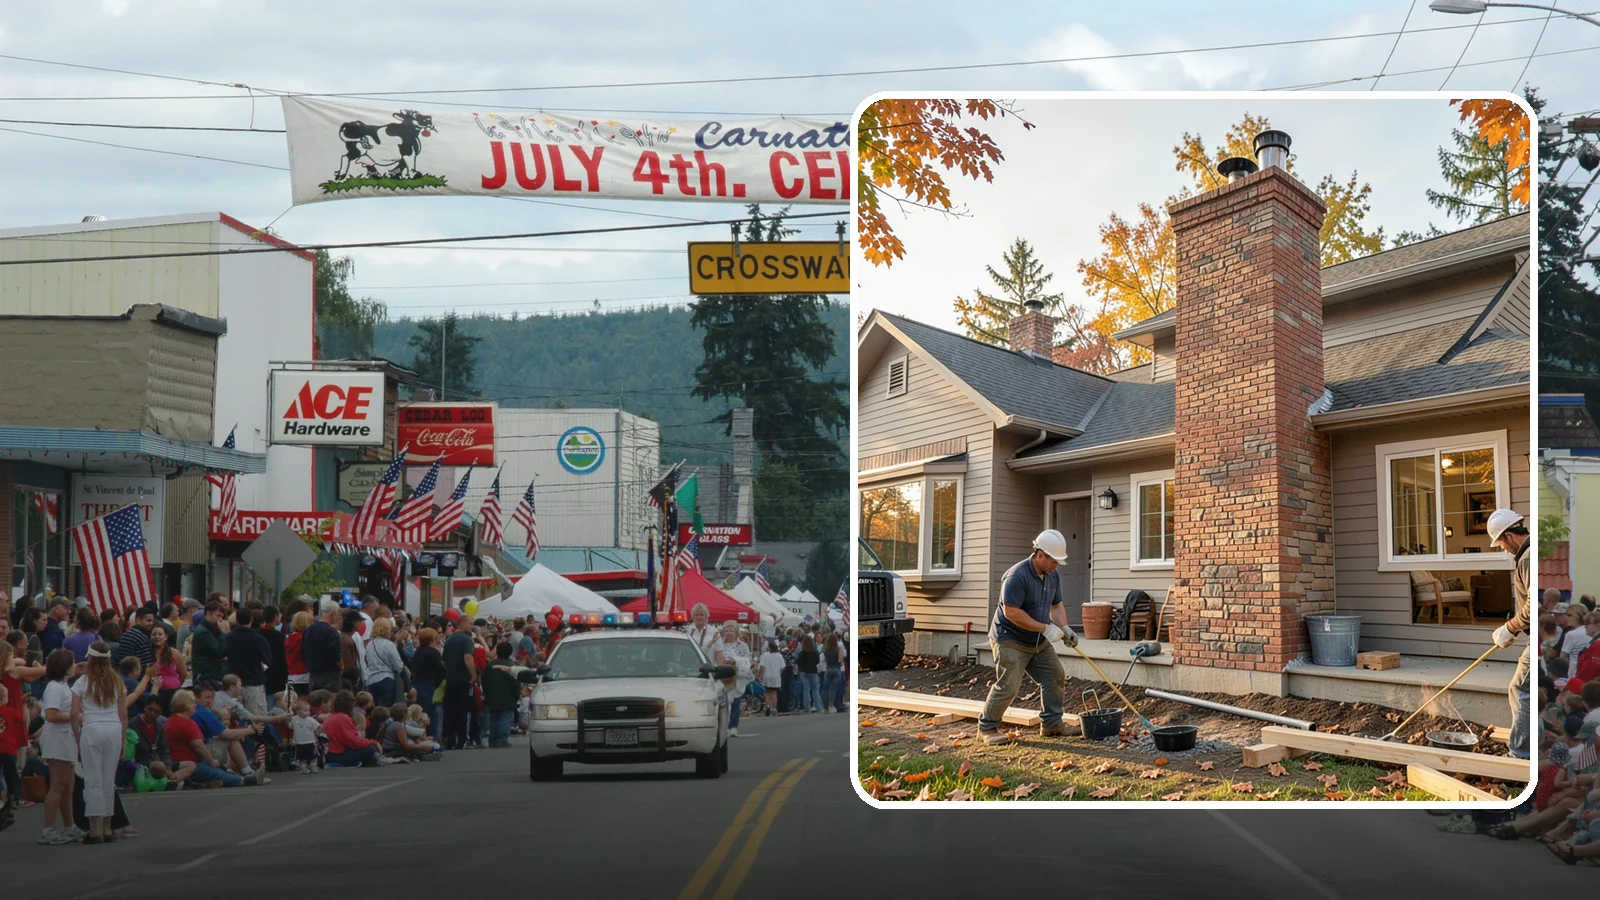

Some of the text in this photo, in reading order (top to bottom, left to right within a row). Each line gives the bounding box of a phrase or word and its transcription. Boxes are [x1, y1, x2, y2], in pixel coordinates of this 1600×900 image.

[481, 141, 605, 192] JULY
[632, 150, 746, 197] 4th.
[697, 254, 850, 280] CROSSWA
[282, 379, 373, 420] ACE
[405, 409, 452, 422] CEDAR
[283, 421, 370, 436] Hardware
[354, 467, 386, 479] Simpl
[83, 485, 155, 495] St. Vincent de Paul
[688, 526, 741, 535] CRNATION
[699, 535, 730, 543] GLASS
